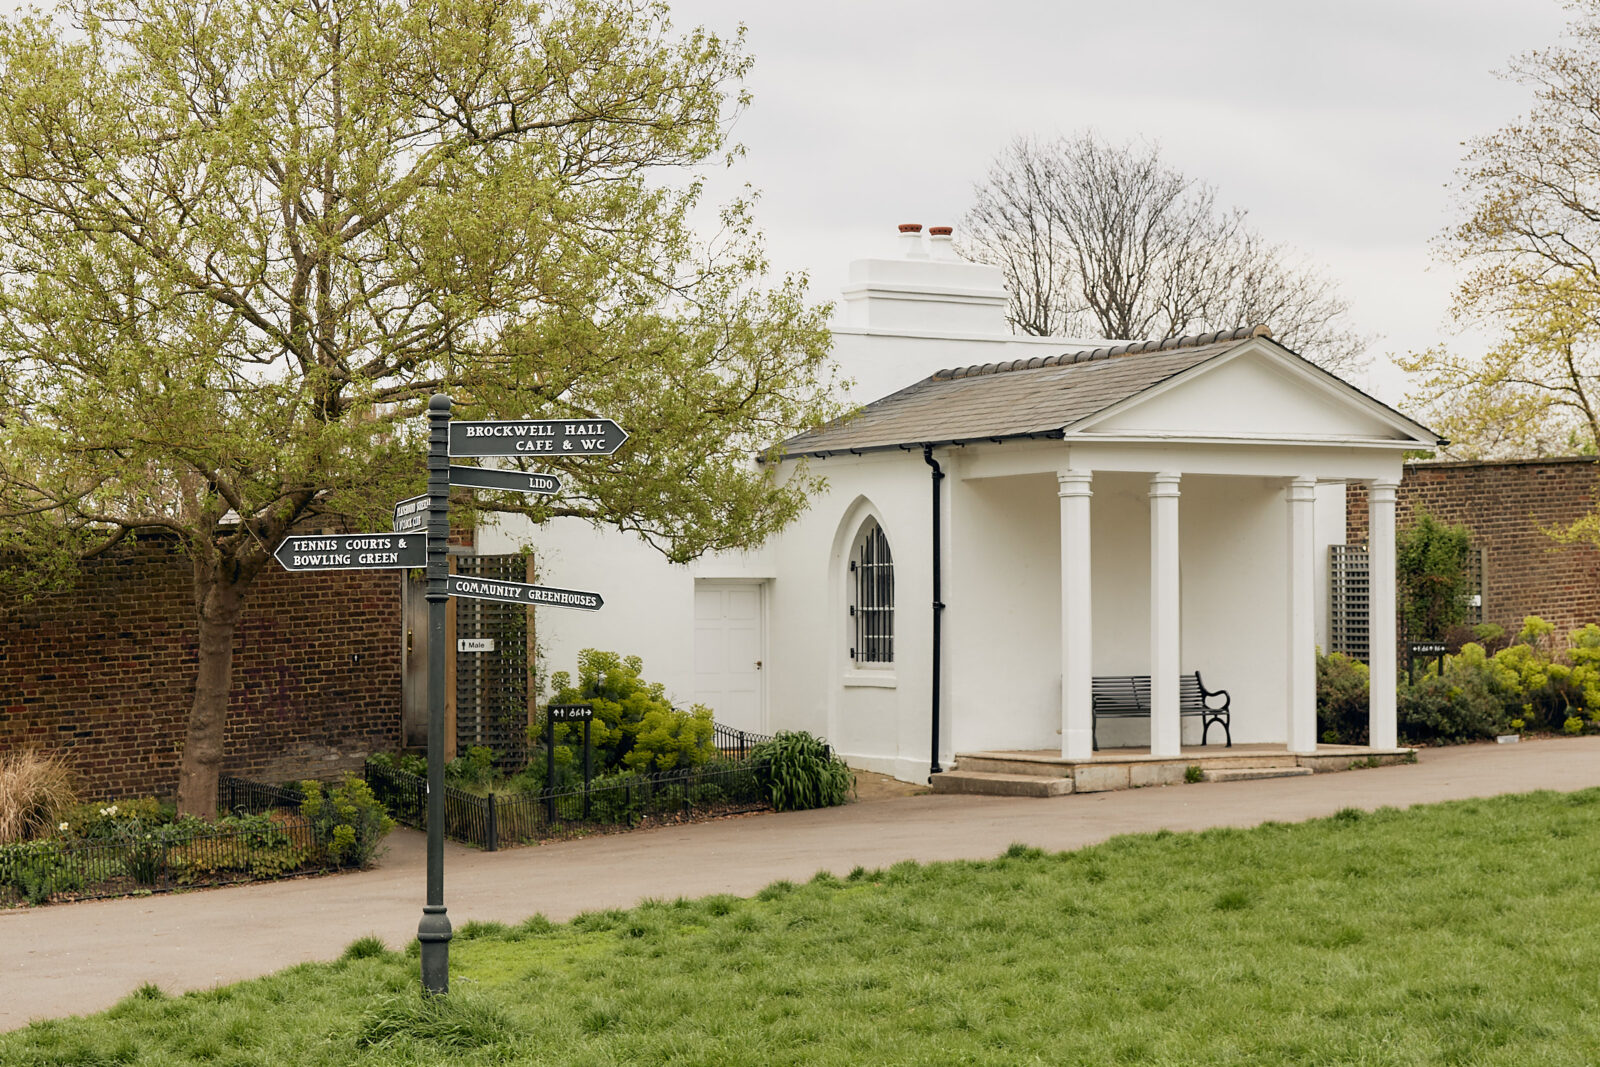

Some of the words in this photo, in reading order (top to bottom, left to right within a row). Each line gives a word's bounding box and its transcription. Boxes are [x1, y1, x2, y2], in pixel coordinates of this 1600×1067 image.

[466, 425, 555, 437] BROCKWELL
[565, 424, 605, 435] HALL
[516, 440, 553, 451] CAFE
[563, 440, 572, 450] &
[582, 439, 606, 450] WC
[529, 478, 553, 489] LIDO
[293, 540, 337, 551] TENNIS
[346, 539, 391, 550] COURTS
[398, 538, 407, 548] &
[293, 554, 351, 565] BOWLING
[359, 553, 398, 564] GREEN
[456, 581, 522, 598] COMMUNITY
[528, 590, 596, 606] GREENHOUSES
